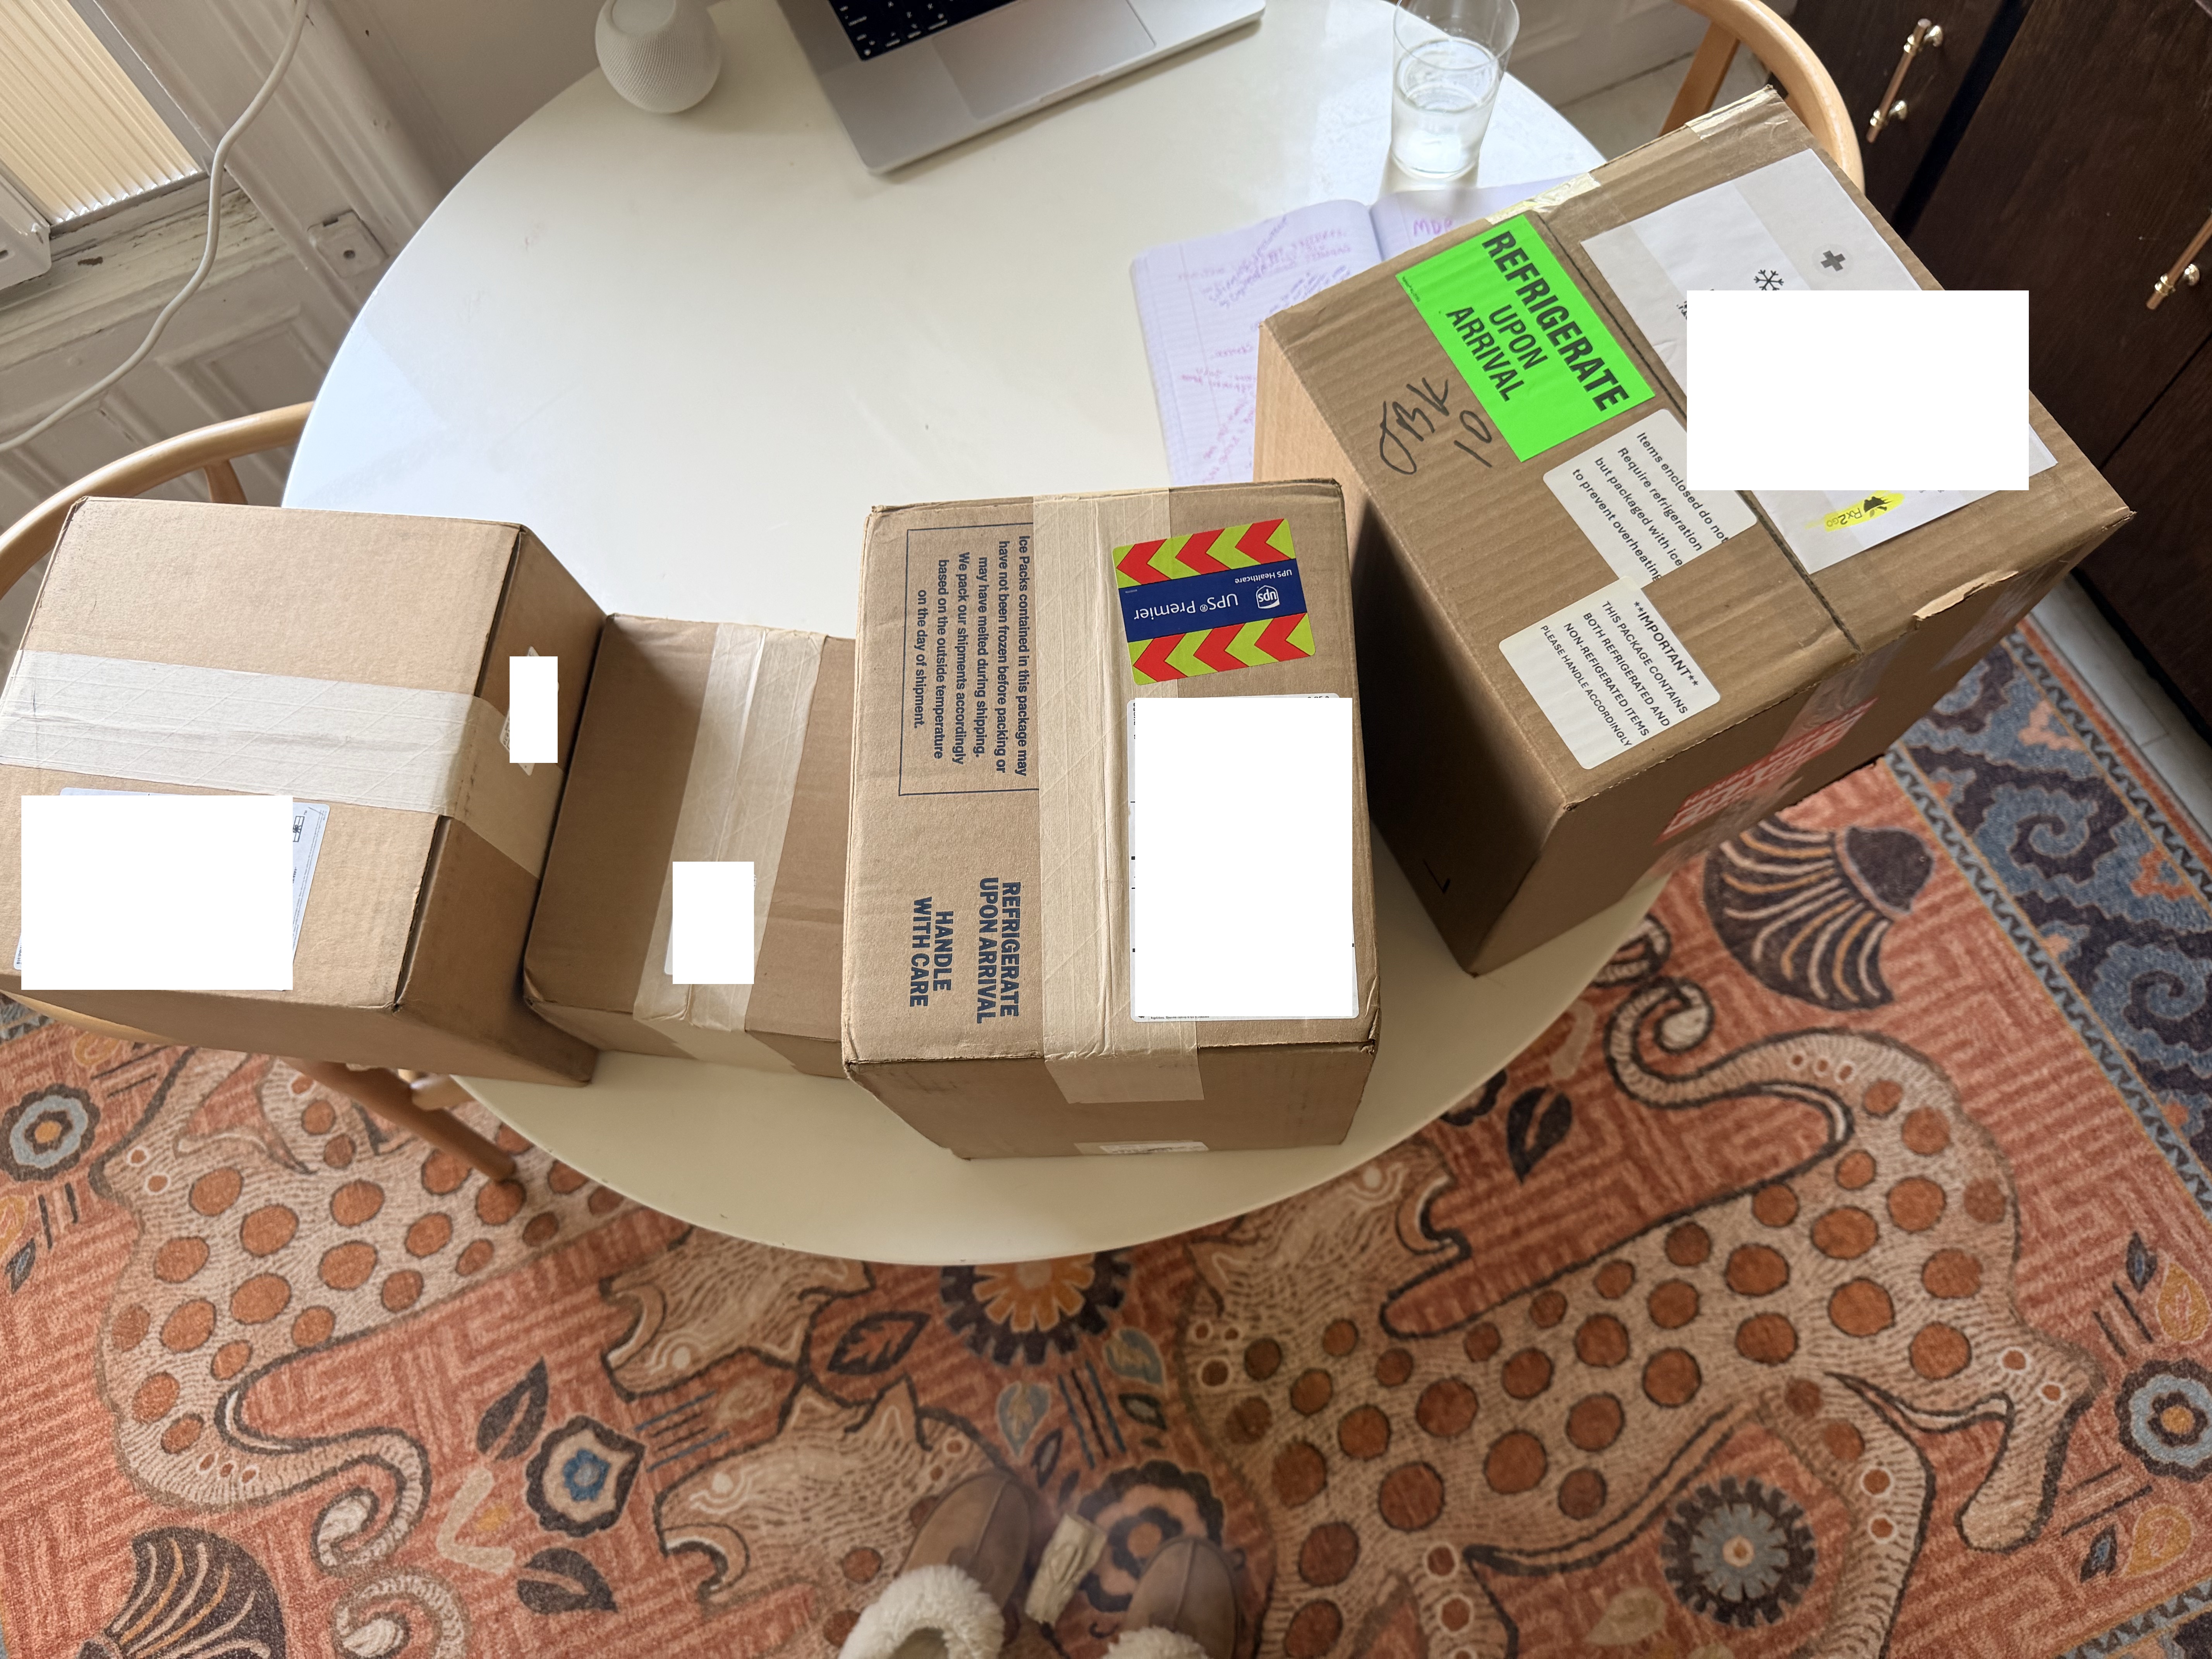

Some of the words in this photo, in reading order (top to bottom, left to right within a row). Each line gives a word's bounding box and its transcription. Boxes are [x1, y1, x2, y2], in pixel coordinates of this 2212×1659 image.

[1481, 230, 1630, 412] REFRIGERATE
[1488, 304, 1548, 370] UPON
[1445, 306, 1524, 402] ARRIVAL
[1572, 469, 1583, 481] to
[1578, 481, 1616, 521] prevent
[1636, 432, 1663, 463] Items
[1661, 463, 1703, 510] enclosed
[1698, 510, 1712, 524] do
[1594, 457, 1613, 477] but
[1606, 476, 1653, 526] packaged
[1648, 525, 1669, 549] with
[1666, 548, 1683, 566] ice
[1617, 447, 1651, 488] Require
[1649, 488, 1702, 551] refrigeration
[958, 551, 970, 571] We
[998, 540, 1010, 570] have
[1018, 535, 1030, 553] Ice
[937, 559, 950, 595] based
[955, 573, 969, 602] pack
[975, 556, 988, 582] may
[998, 571, 1009, 591] not
[1018, 555, 1030, 591] Packs
[1234, 572, 1276, 584] Healthcare
[1276, 569, 1292, 578] UPS
[917, 589, 927, 605] on
[917, 607, 929, 627] the
[937, 597, 946, 613] on
[957, 604, 967, 625] our
[977, 584, 990, 613] have
[998, 593, 1010, 623] been
[1133, 600, 1196, 620] Premier
[913, 629, 928, 651] day
[937, 615, 948, 635] the
[977, 615, 989, 656] melted
[1018, 593, 1030, 653] contained
[915, 653, 927, 666] of
[936, 637, 948, 683] outside
[954, 627, 969, 690] shipments
[997, 625, 1010, 663] frozen
[1018, 655, 1030, 667] in
[1602, 600, 1621, 623] THIS
[1616, 622, 1653, 666] PACKAGE
[1649, 666, 1688, 714] CONTAINS
[974, 658, 989, 698] during
[997, 665, 1009, 705] before
[1018, 669, 1030, 693] this
[1540, 625, 1565, 656] PLEASE
[1561, 654, 1589, 689] HANDLE
[1584, 689, 1632, 746] ACCORDINGLY
[1563, 622, 1628, 707] NON-REFIGERATED
[1624, 707, 1649, 736] ITEMS
[1583, 612, 1606, 638] BOTH
[1601, 637, 1654, 705] REFRIGERATED
[1649, 706, 1670, 726] AND
[912, 669, 927, 729] shipment.
[932, 684, 946, 759] temperature
[951, 692, 967, 764] accordingly
[972, 700, 988, 757] shipping.
[993, 707, 1008, 756] packing
[1015, 695, 1029, 747] package
[996, 759, 1006, 773] or
[1014, 749, 1027, 776] may
[912, 896, 932, 948] WITH
[979, 877, 999, 933] UPON
[933, 910, 954, 991] HANDLE
[1000, 881, 1021, 1017] REFRIGERATE
[909, 953, 930, 1007] CARE
[976, 936, 998, 1024] ARRIVAL
